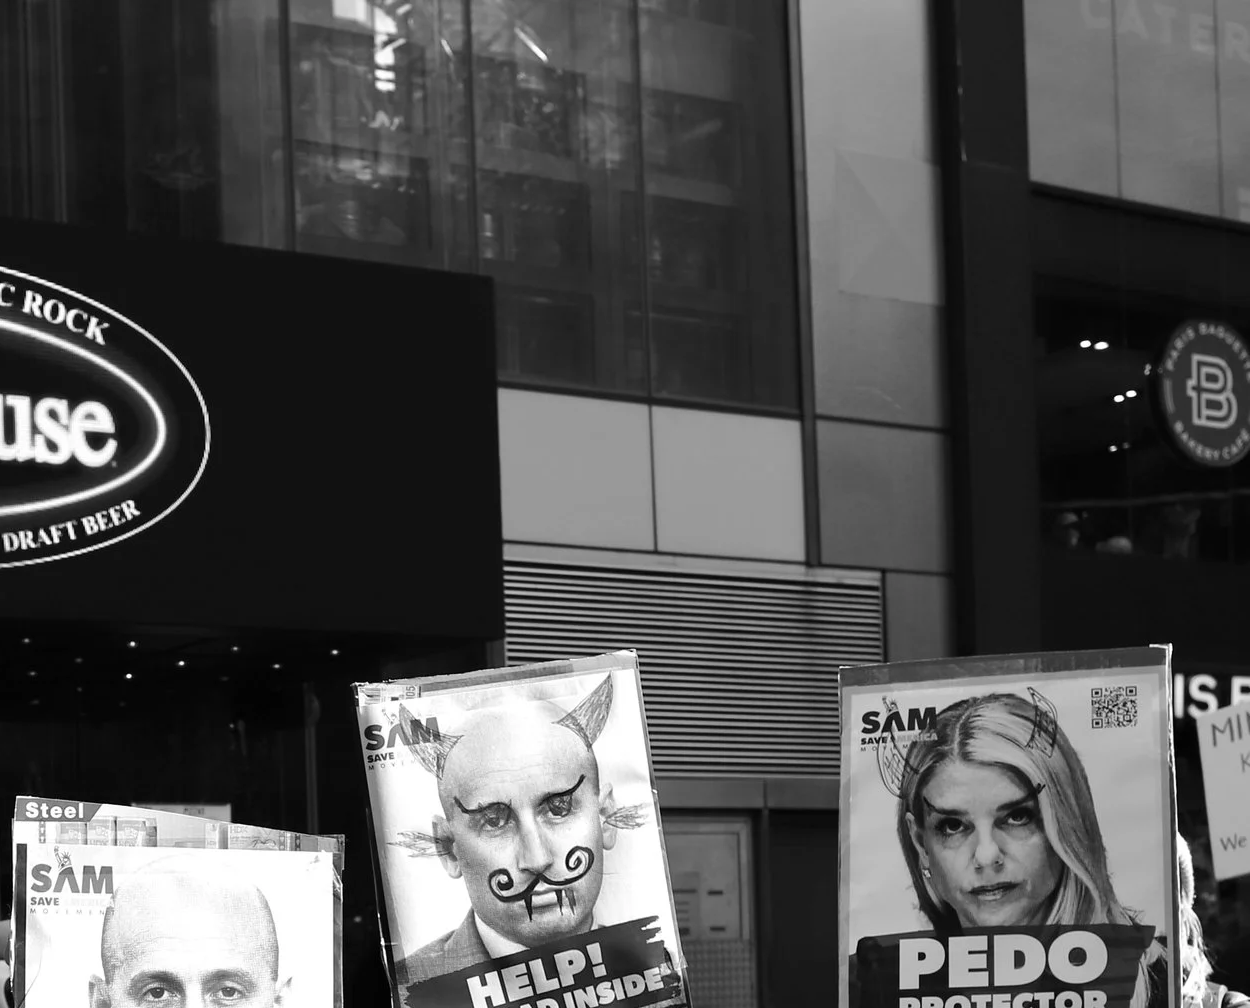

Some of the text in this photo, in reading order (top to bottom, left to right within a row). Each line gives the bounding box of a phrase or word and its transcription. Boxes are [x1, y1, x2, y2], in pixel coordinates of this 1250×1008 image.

[22, 289, 110, 346] ROCK
[2, 519, 77, 552] DRAFT
[81, 499, 141, 536] BEER
[861, 706, 938, 734] SAM
[860, 736, 888, 745] SAVE
[367, 752, 395, 764] SAVE
[25, 801, 84, 819] Steel
[1219, 832, 1247, 852] We
[30, 863, 114, 895] SAM
[30, 897, 60, 906] SAVE
[899, 930, 1109, 990] PEDO
